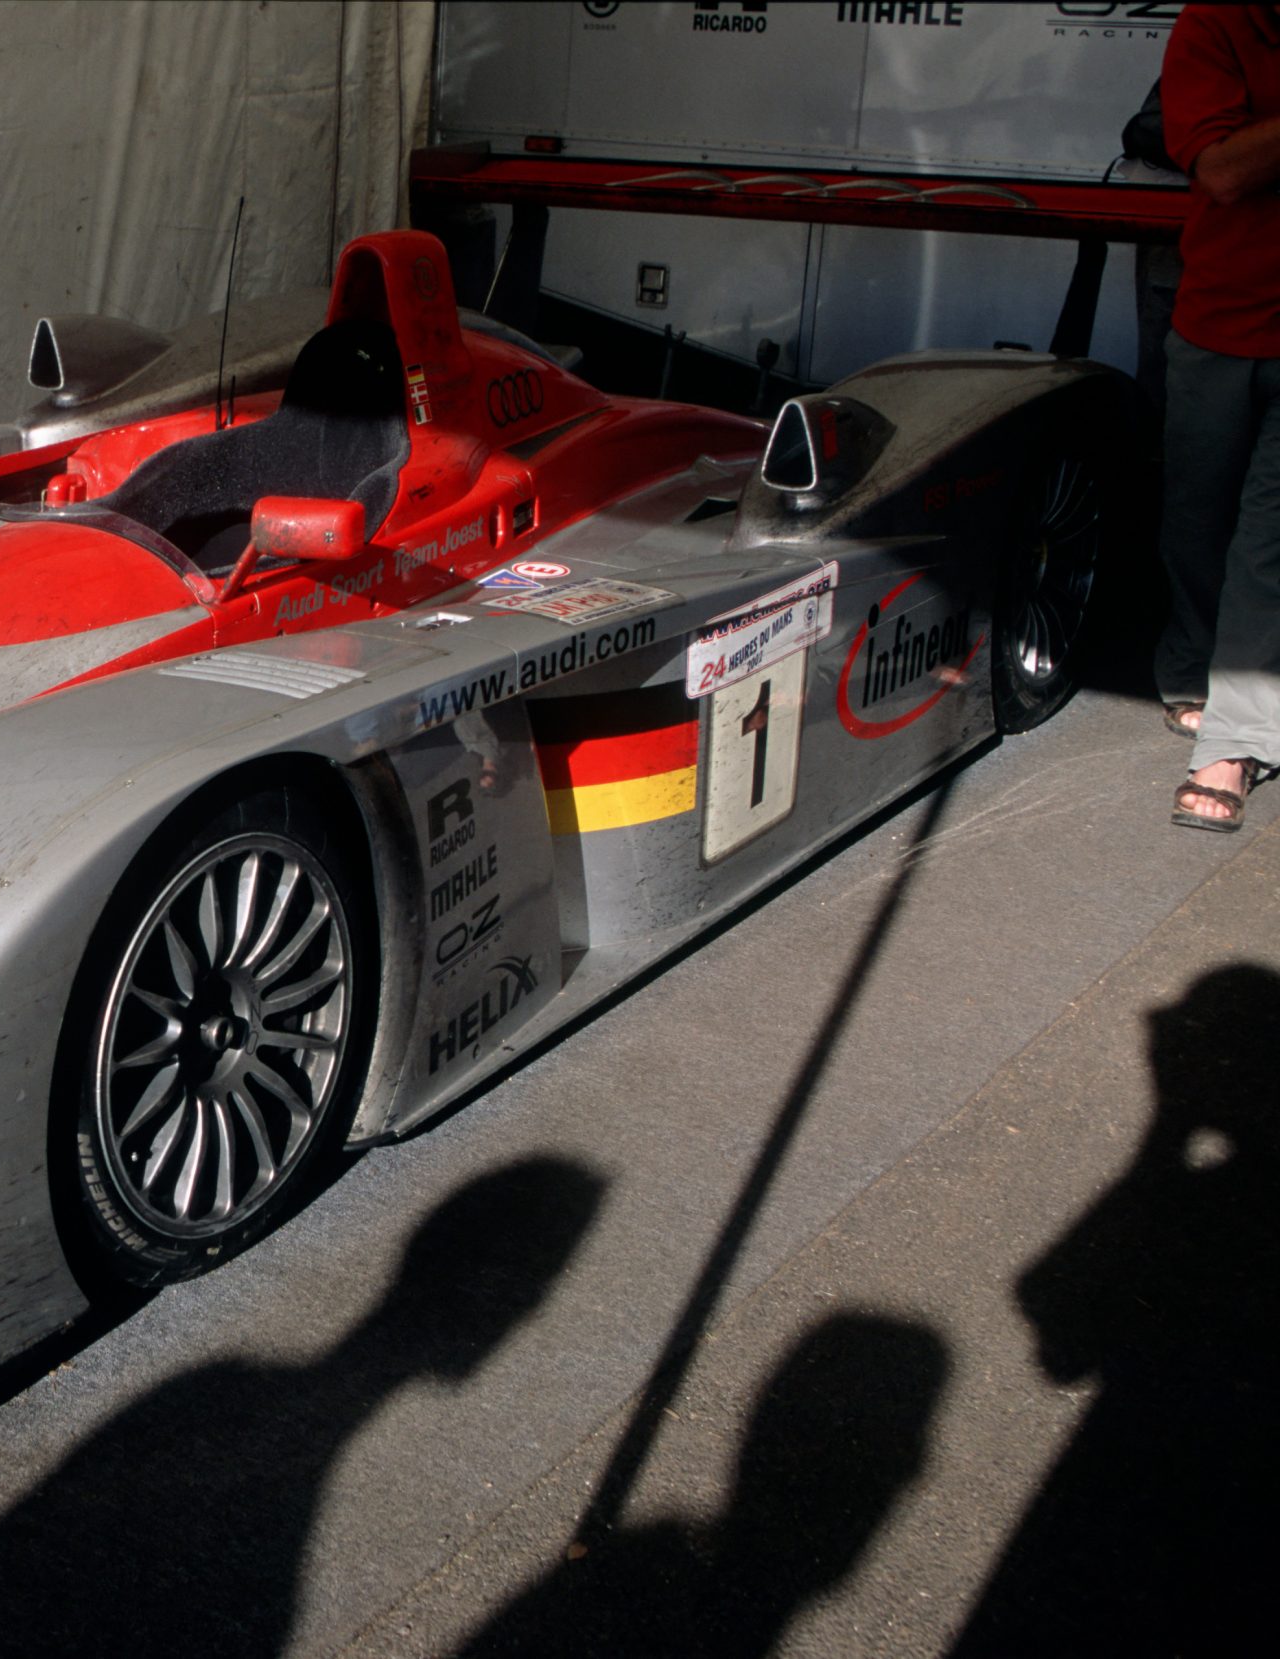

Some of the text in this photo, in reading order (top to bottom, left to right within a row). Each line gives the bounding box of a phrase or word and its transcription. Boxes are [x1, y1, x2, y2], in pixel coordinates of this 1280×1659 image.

[693, 13, 767, 33] RICARDO
[836, 1, 964, 27] MAHLE
[1053, 28, 1159, 40] RACIN
[273, 515, 484, 627] Audi Sport Team Joest
[419, 617, 656, 729] www.audi.com
[699, 653, 726, 691] 24
[728, 637, 758, 673] HEURES
[759, 625, 770, 649] DU
[771, 607, 793, 638] MANS
[740, 678, 771, 809] 1
[427, 777, 474, 843] R
[430, 819, 476, 868] RICARDO
[430, 844, 499, 922] MAHLE
[436, 934, 503, 987] RACING
[429, 953, 539, 1077] HELIX
[76, 1132, 150, 1252] MICHELIN
